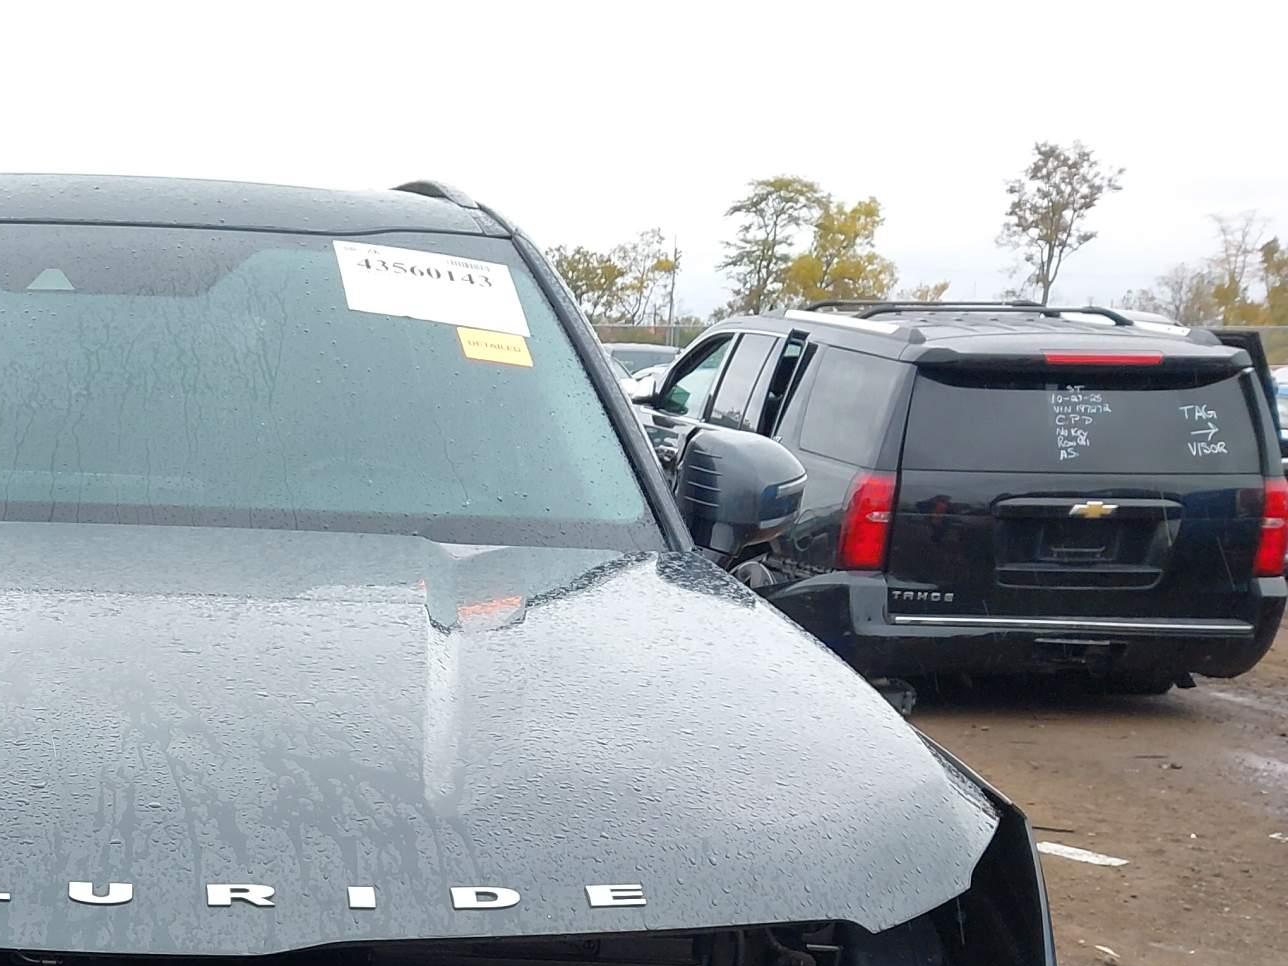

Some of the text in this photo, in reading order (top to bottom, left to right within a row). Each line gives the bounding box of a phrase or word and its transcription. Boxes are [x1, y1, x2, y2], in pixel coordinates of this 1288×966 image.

[357, 258, 493, 288] 43560143
[1053, 405, 1072, 413] VIN
[1179, 404, 1218, 420] TAG
[1187, 441, 1228, 456] VISOR
[892, 590, 954, 602] TAHOE
